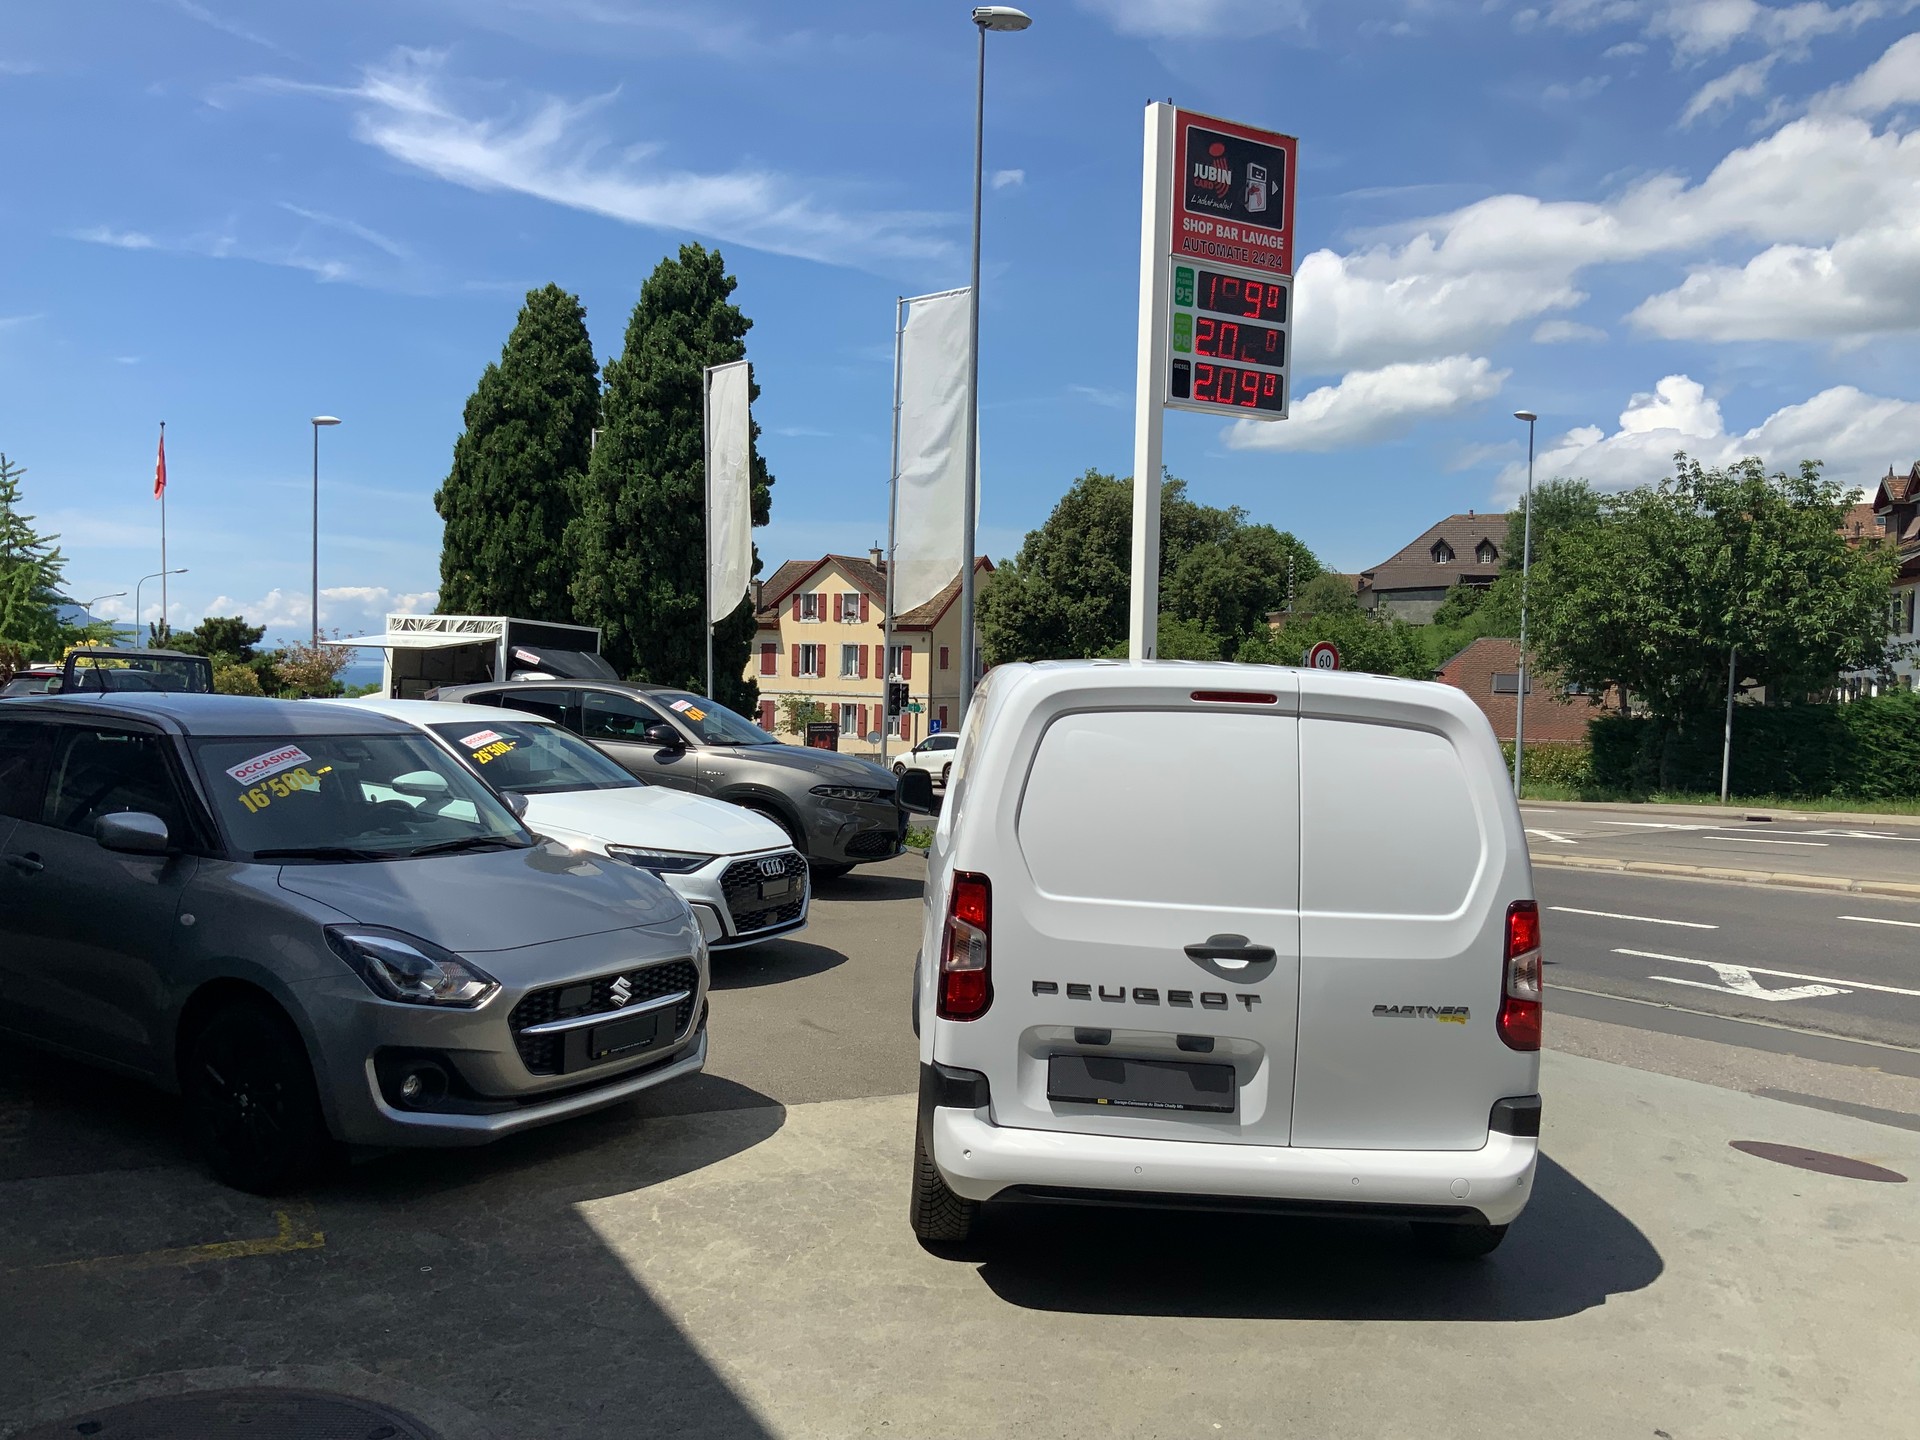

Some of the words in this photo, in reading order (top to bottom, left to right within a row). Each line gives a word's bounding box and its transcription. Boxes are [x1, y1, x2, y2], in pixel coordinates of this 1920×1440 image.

[1193, 162, 1232, 186] JUBIN
[1183, 217, 1214, 235] SHOP
[1216, 224, 1239, 241] BAR
[1242, 229, 1284, 250] LAVAGE
[1182, 236, 1249, 263] AUTOMATE
[1175, 286, 1193, 303] 95
[1319, 654, 1332, 668] 60
[234, 748, 302, 778] OCCASION
[1031, 979, 1263, 1013] PEUGEOT
[1372, 1004, 1469, 1016] PARTNER
